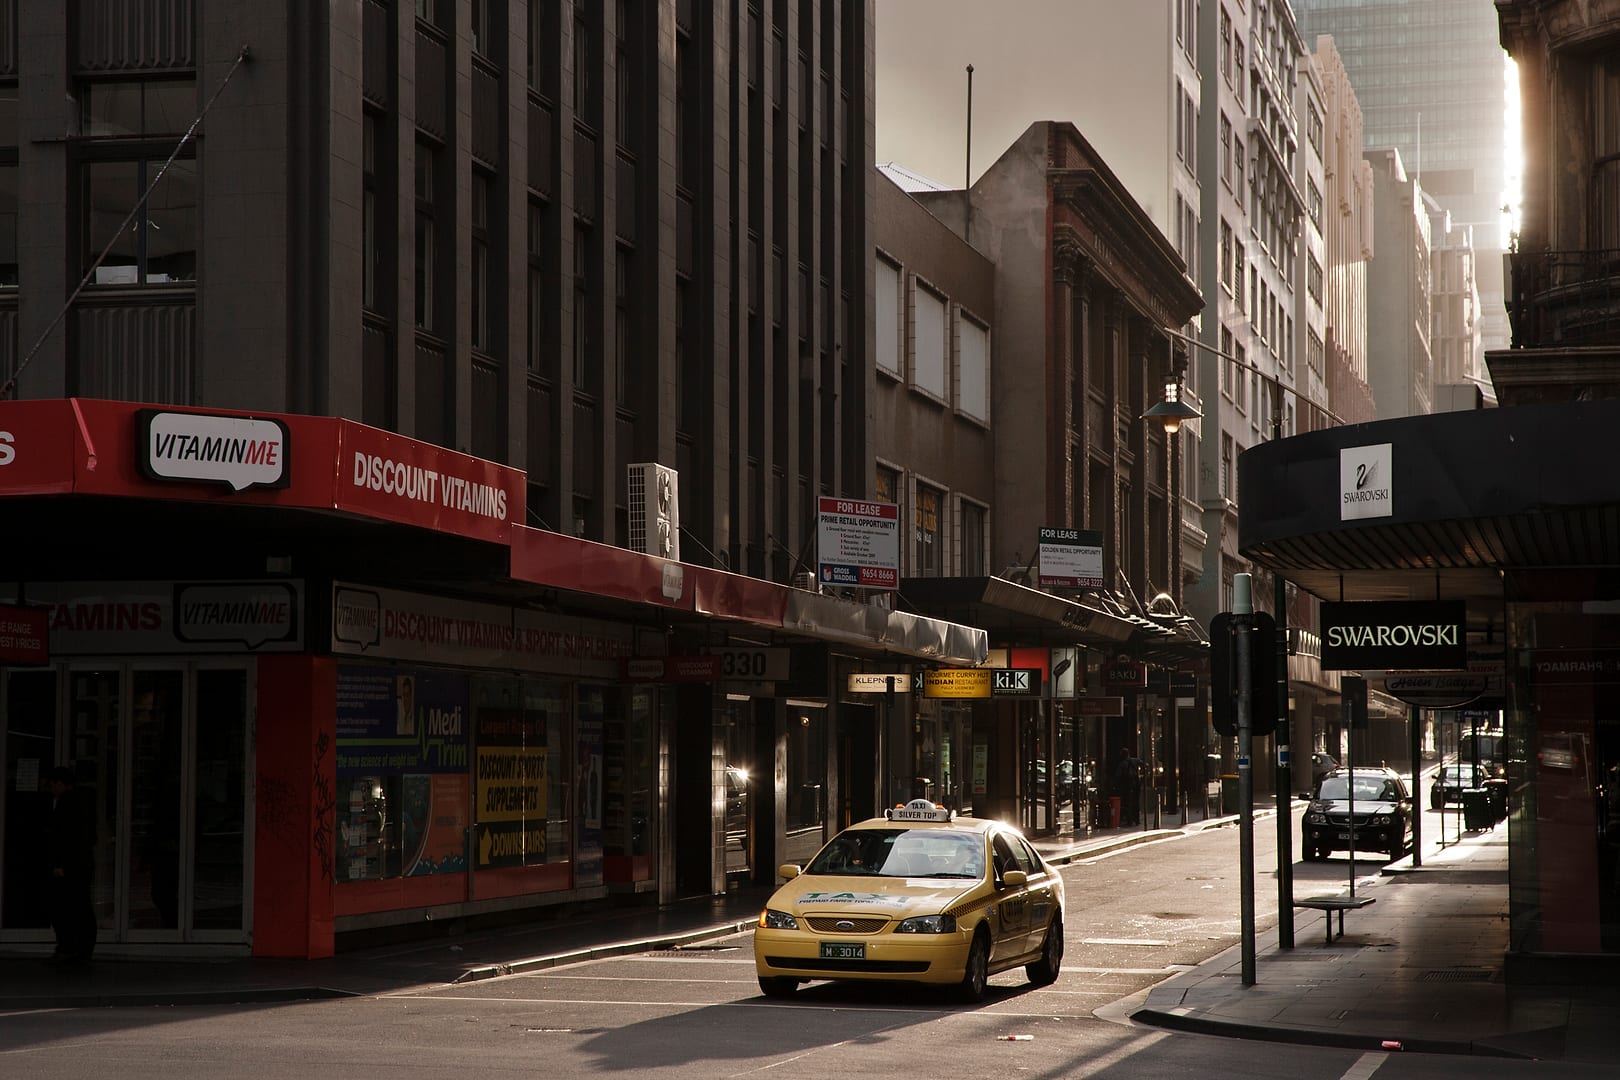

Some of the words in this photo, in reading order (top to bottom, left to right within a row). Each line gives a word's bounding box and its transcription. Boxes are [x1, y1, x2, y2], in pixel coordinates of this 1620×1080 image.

[155, 432, 279, 466] VITAMINME
[353, 451, 438, 504] DISCOUNT
[441, 475, 507, 521] VITAMINS
[1343, 488, 1389, 504] SWAROVSKI
[837, 502, 853, 513] FOR
[855, 503, 881, 516] LEASE
[821, 515, 838, 524] PRIME
[839, 516, 858, 526] RETAIL
[858, 518, 896, 530] OPPORTUNITY
[1041, 529, 1055, 538] FOR
[1057, 530, 1078, 540] LEASE
[833, 573, 857, 582] WADDELL
[862, 568, 877, 578] 9654
[878, 570, 894, 580] 8666
[1077, 577, 1090, 586] 9654
[1090, 578, 1104, 587] 3222
[183, 602, 287, 625] VITAMINME
[8, 621, 33, 634] RANGE
[384, 609, 454, 646] DISCOUNT
[455, 621, 513, 652] VITAMINS
[515, 631, 524, 653] &
[525, 631, 562, 656] SPORT
[0, 636, 15, 648] EST
[16, 637, 41, 650] PRICES
[1328, 624, 1459, 648] SWAROVSKI
[722, 652, 767, 676] 330
[1109, 671, 1137, 680] BAKU
[428, 704, 462, 736] Medi
[431, 738, 467, 768] Trim
[479, 753, 516, 780] DISCOUNT
[518, 753, 545, 779] SPORTS
[486, 785, 538, 812] SUPPLEMENTS
[911, 802, 926, 810] TAXI
[898, 810, 921, 819] SILVER
[922, 811, 937, 819] TOP
[492, 829, 545, 857] DOWNSTAIRS
[825, 947, 833, 957] M
[839, 948, 864, 958] 3014
